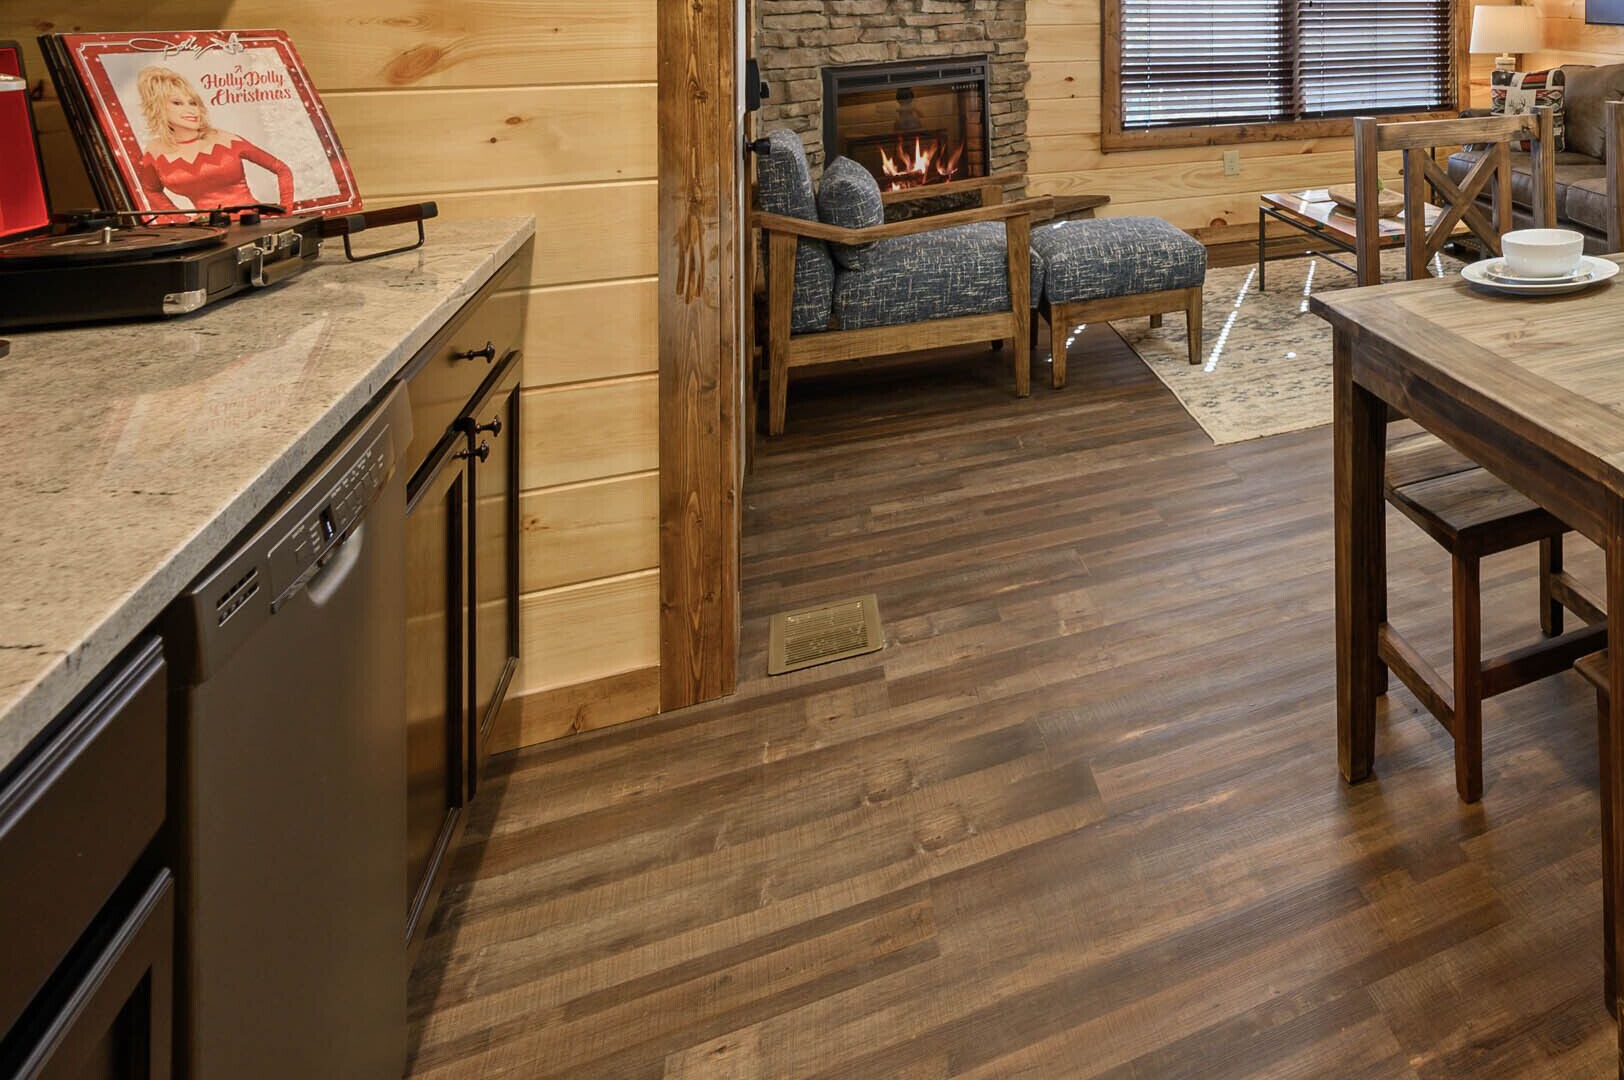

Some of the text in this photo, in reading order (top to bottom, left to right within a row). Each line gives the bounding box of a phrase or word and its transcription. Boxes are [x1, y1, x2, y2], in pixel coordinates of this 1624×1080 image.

[128, 36, 222, 60] Dolly
[201, 70, 286, 89] Holly Dolly
[211, 88, 292, 106] Christmas
